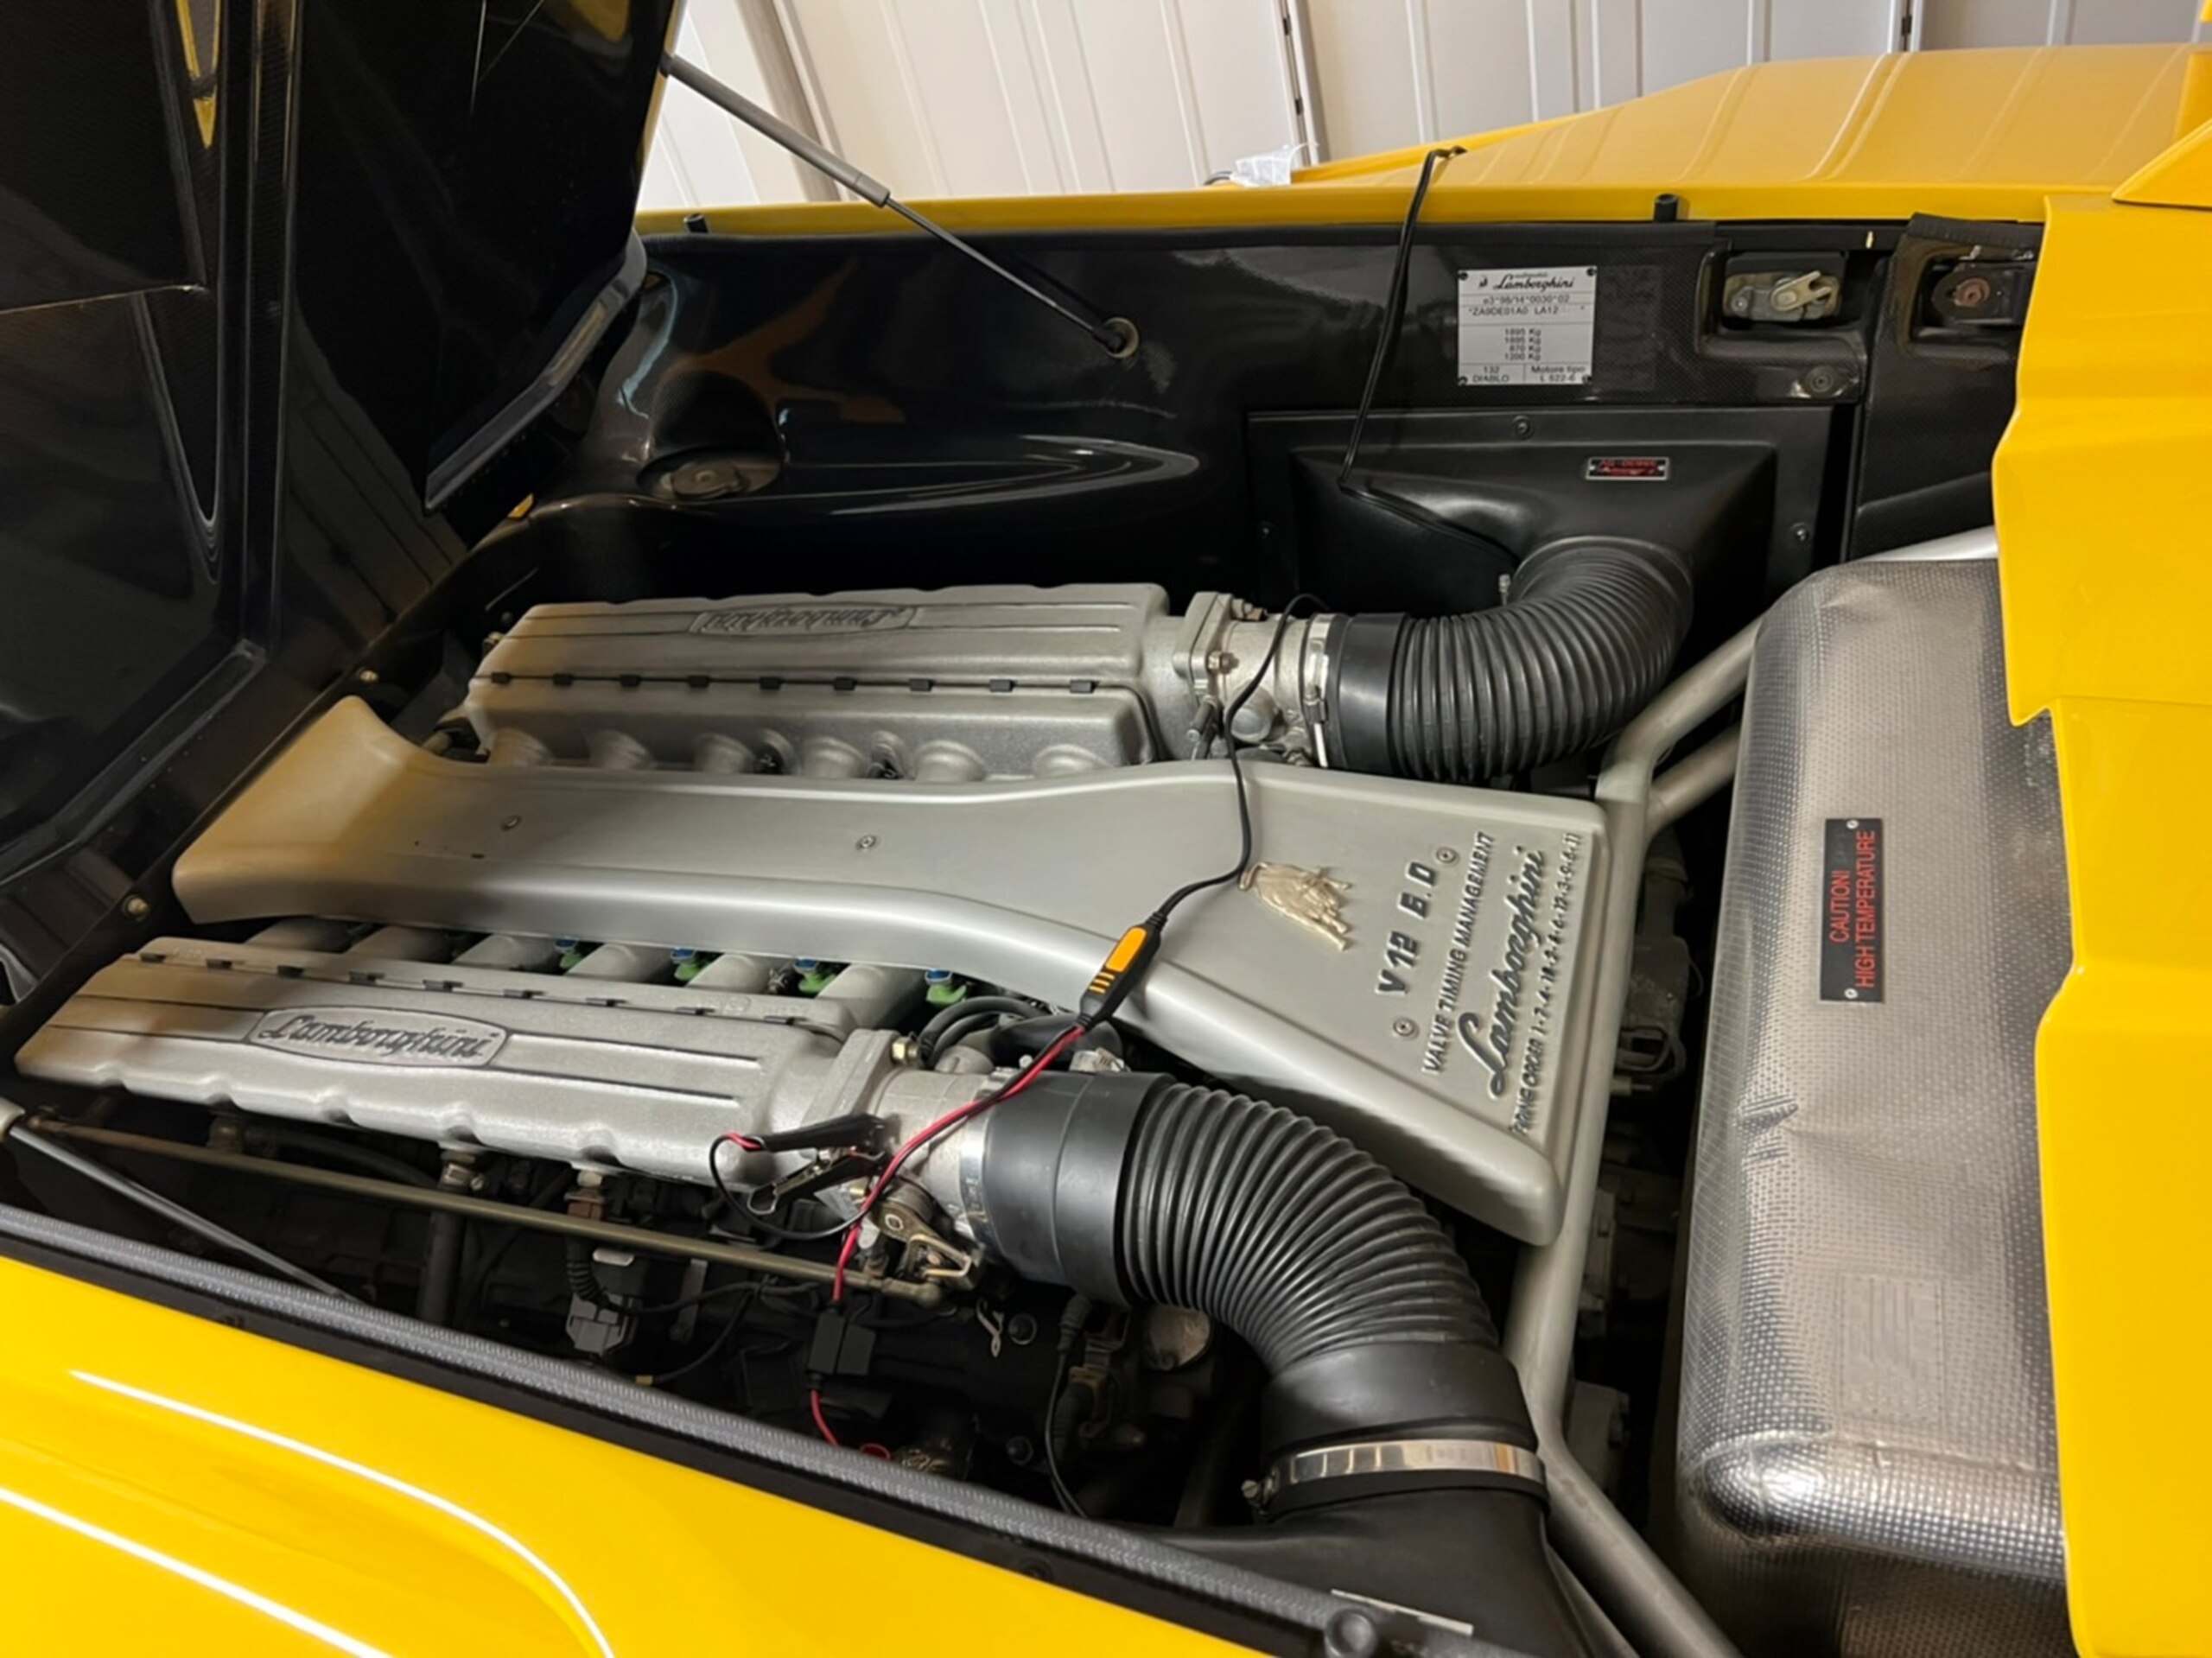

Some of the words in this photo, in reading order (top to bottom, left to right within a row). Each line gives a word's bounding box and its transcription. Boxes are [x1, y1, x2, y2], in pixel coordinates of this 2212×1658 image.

[1493, 272, 1575, 292] Lamborghini
[1528, 327, 1541, 337] Kg
[1528, 336, 1541, 345] Kg
[1528, 345, 1541, 353] Kg
[1528, 353, 1541, 361] Kg
[1471, 374, 1510, 383] DIABLO
[1566, 365, 1586, 374] tipo
[700, 607, 904, 632] Lamborghini
[1855, 830, 1875, 943] TEMPERATURE
[1421, 1013, 1452, 1075] VALVE
[1437, 949, 1467, 1012] TIMING
[1452, 831, 1495, 949] MANAGEMENT
[1457, 845, 1546, 1099] Lamborghini
[1854, 946, 1875, 988] HIGH
[257, 1014, 499, 1059] Lamborghini
[1521, 1039, 1542, 1088] ORDER
